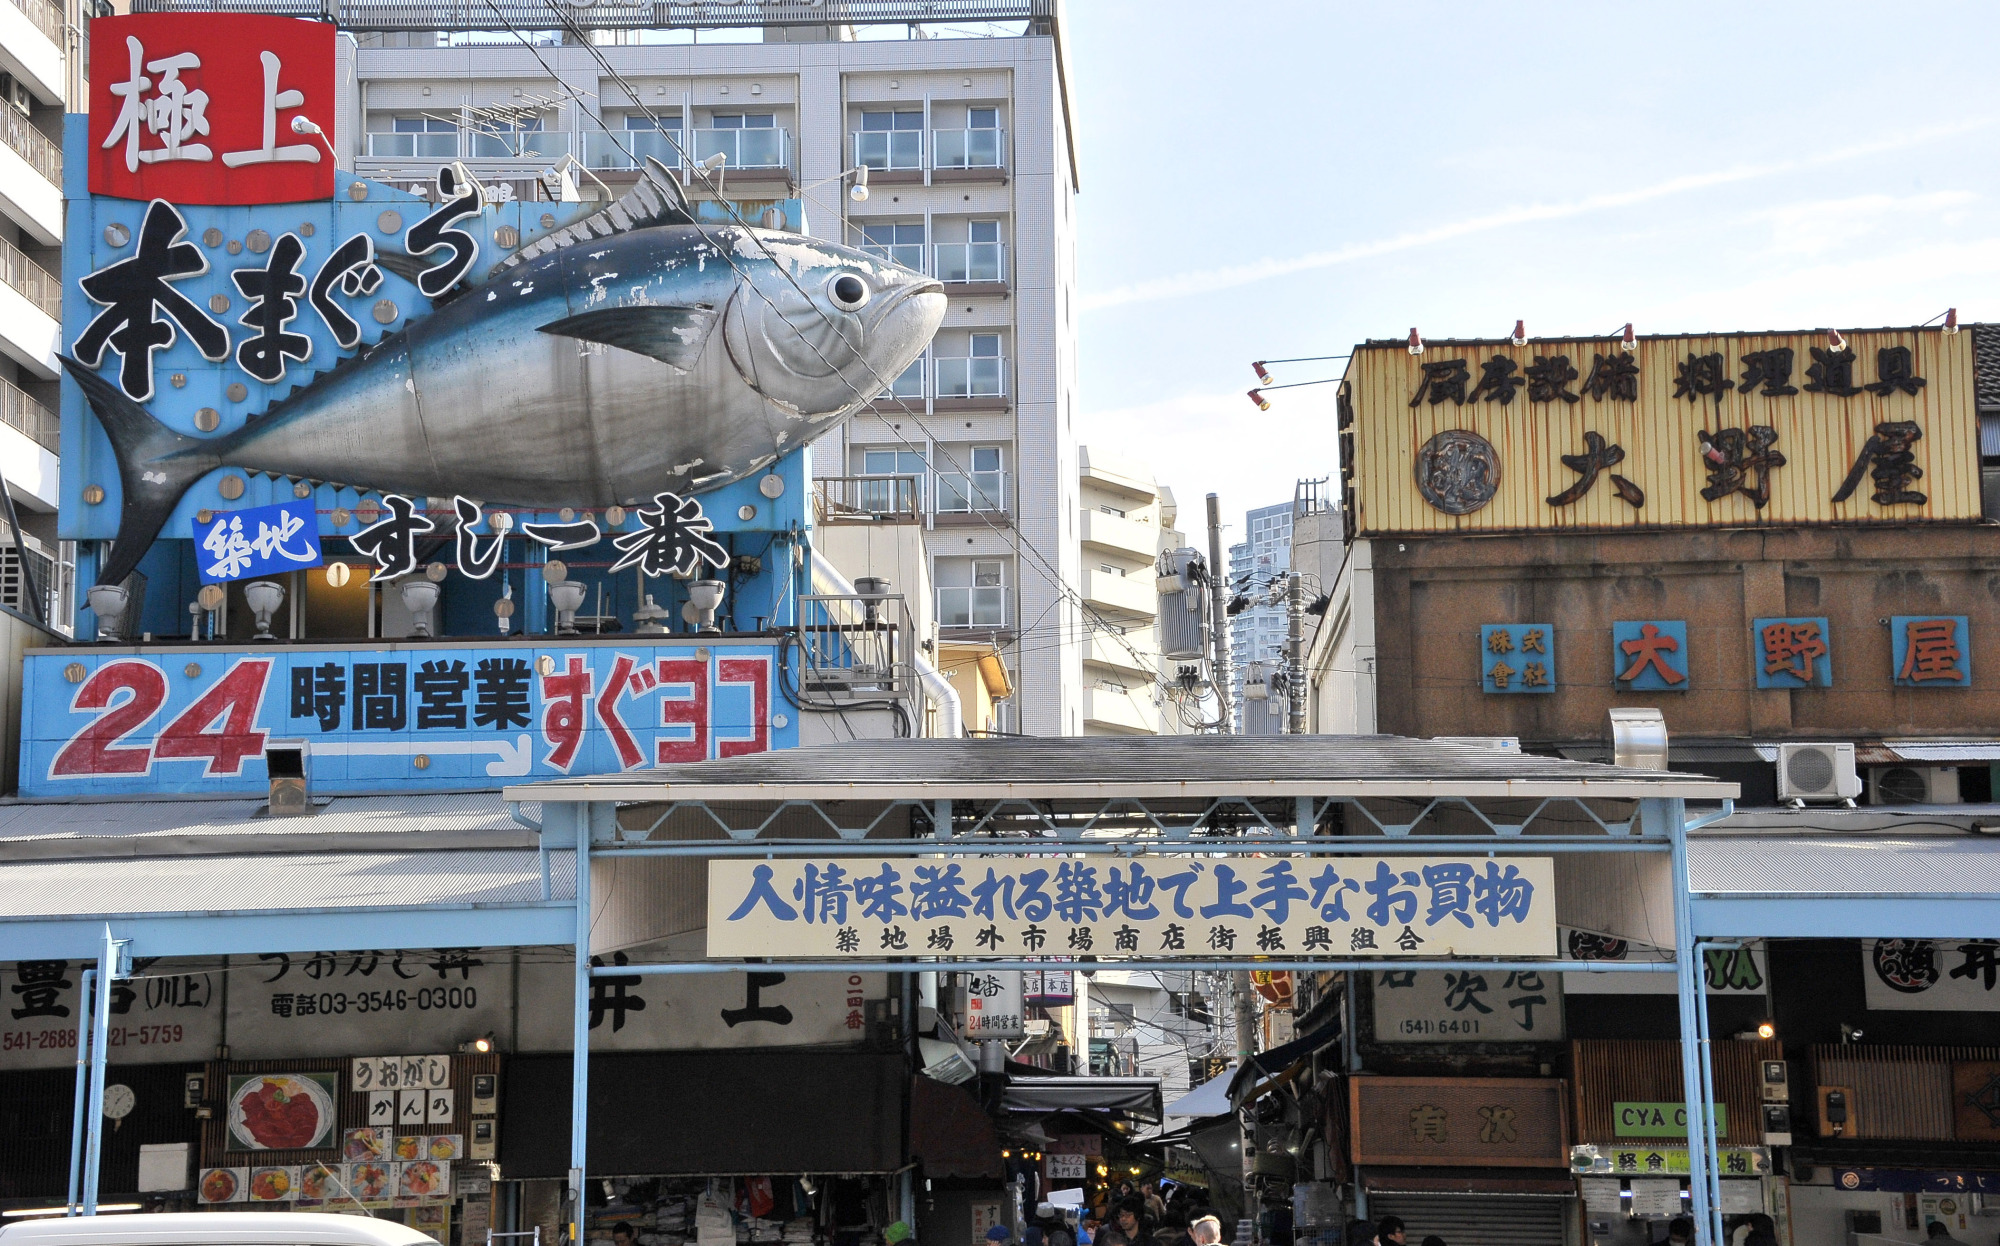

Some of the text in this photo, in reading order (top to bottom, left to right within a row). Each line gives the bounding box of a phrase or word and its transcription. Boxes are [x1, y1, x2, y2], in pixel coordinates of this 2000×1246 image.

[101, 35, 321, 174] 極上
[72, 163, 485, 402] 本まぐろ
[1672, 345, 1928, 403] 料理道具
[1545, 419, 1928, 509] 大野屋
[202, 508, 319, 579] 築地
[348, 491, 731, 582] すし一番
[1618, 619, 1964, 686] 大野屋
[538, 651, 774, 773] すぐヨコ
[726, 860, 1535, 929] 人情味溢れる築地で上手なお買物
[835, 923, 1426, 953] 築地場外市場商店街振興組合
[106, 1023, 184, 1046] 21-5759
[357, 1058, 446, 1089] うおがし
[1621, 1108, 1666, 1127] CYA
[1617, 1151, 1665, 1173] 軽食
